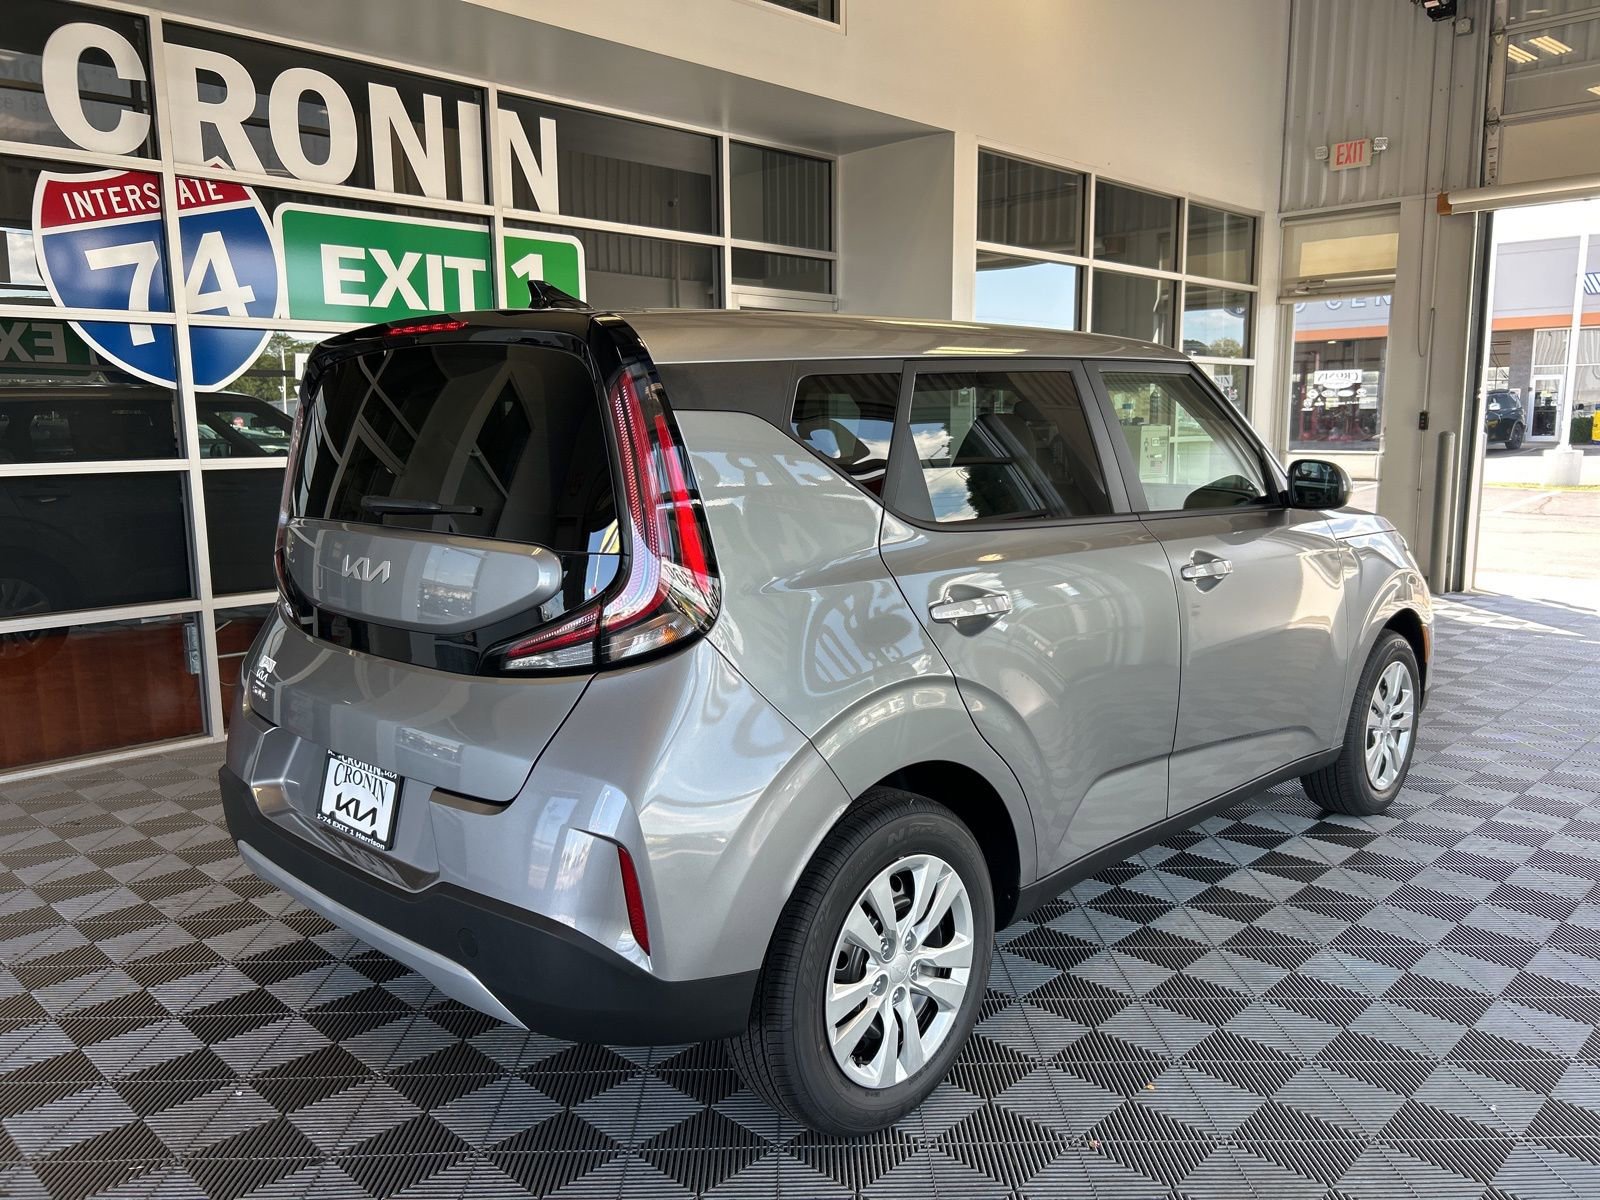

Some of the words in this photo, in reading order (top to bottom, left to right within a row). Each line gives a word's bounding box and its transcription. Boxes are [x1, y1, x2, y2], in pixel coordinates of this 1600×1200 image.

[42, 22, 559, 215] CRONIN
[1336, 140, 1366, 166] EXIT
[62, 178, 224, 220] INTERSATE
[84, 231, 256, 347] 74
[320, 243, 487, 312] EXIT
[342, 554, 392, 584] KIA
[333, 762, 389, 808] CRONIN
[335, 792, 378, 828] KIA
[316, 813, 331, 825] I-74
[332, 820, 350, 833] EXIT
[355, 831, 386, 851] Harrison
